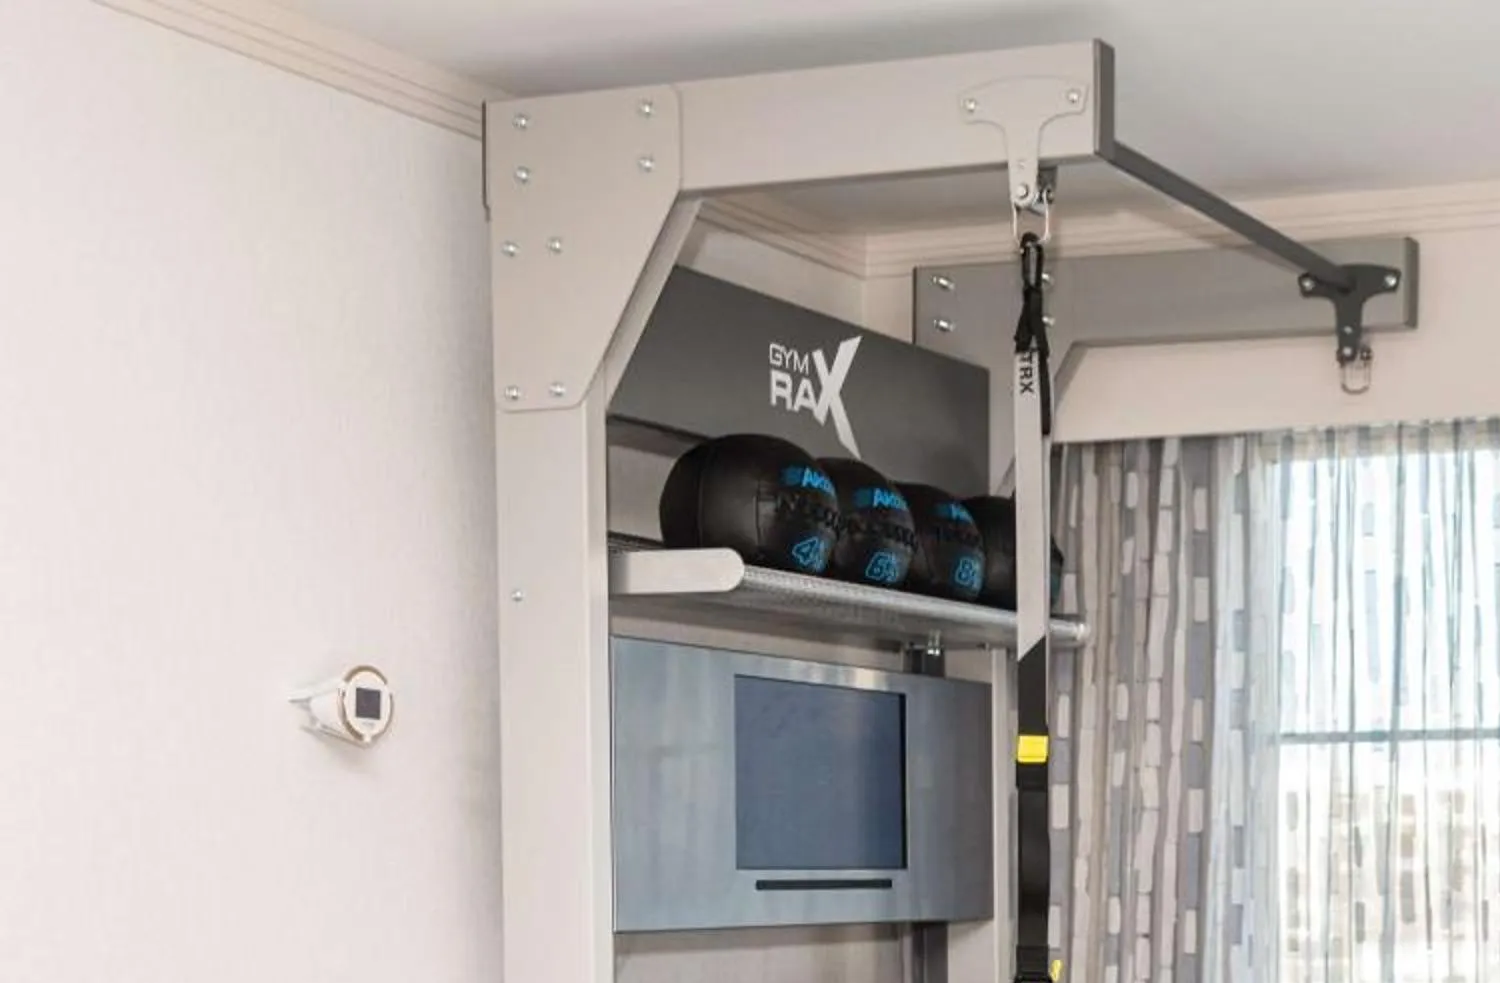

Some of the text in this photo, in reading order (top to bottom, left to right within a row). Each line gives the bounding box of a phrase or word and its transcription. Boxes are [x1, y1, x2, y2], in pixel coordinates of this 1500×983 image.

[769, 343, 809, 375] GYM
[1019, 351, 1034, 393] TRX
[770, 336, 863, 460] RAX
